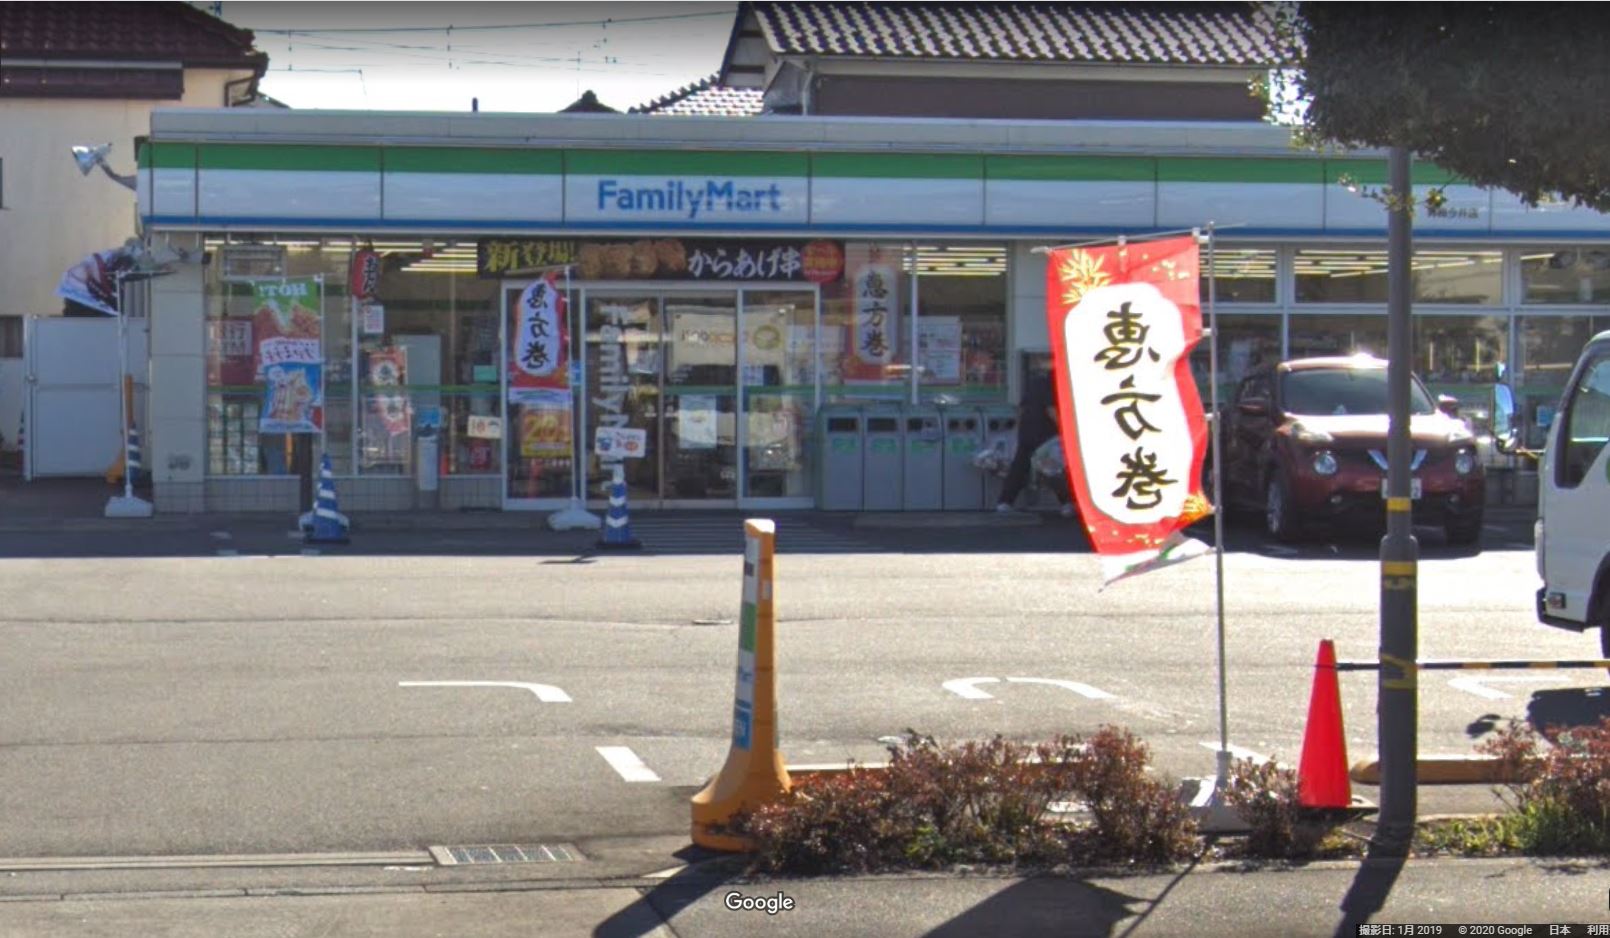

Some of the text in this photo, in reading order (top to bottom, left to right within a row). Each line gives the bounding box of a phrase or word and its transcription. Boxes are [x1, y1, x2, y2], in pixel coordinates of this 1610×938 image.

[597, 179, 782, 219] FamilyMart
[688, 246, 801, 279] からあげ串
[860, 270, 888, 358] 恵方巻
